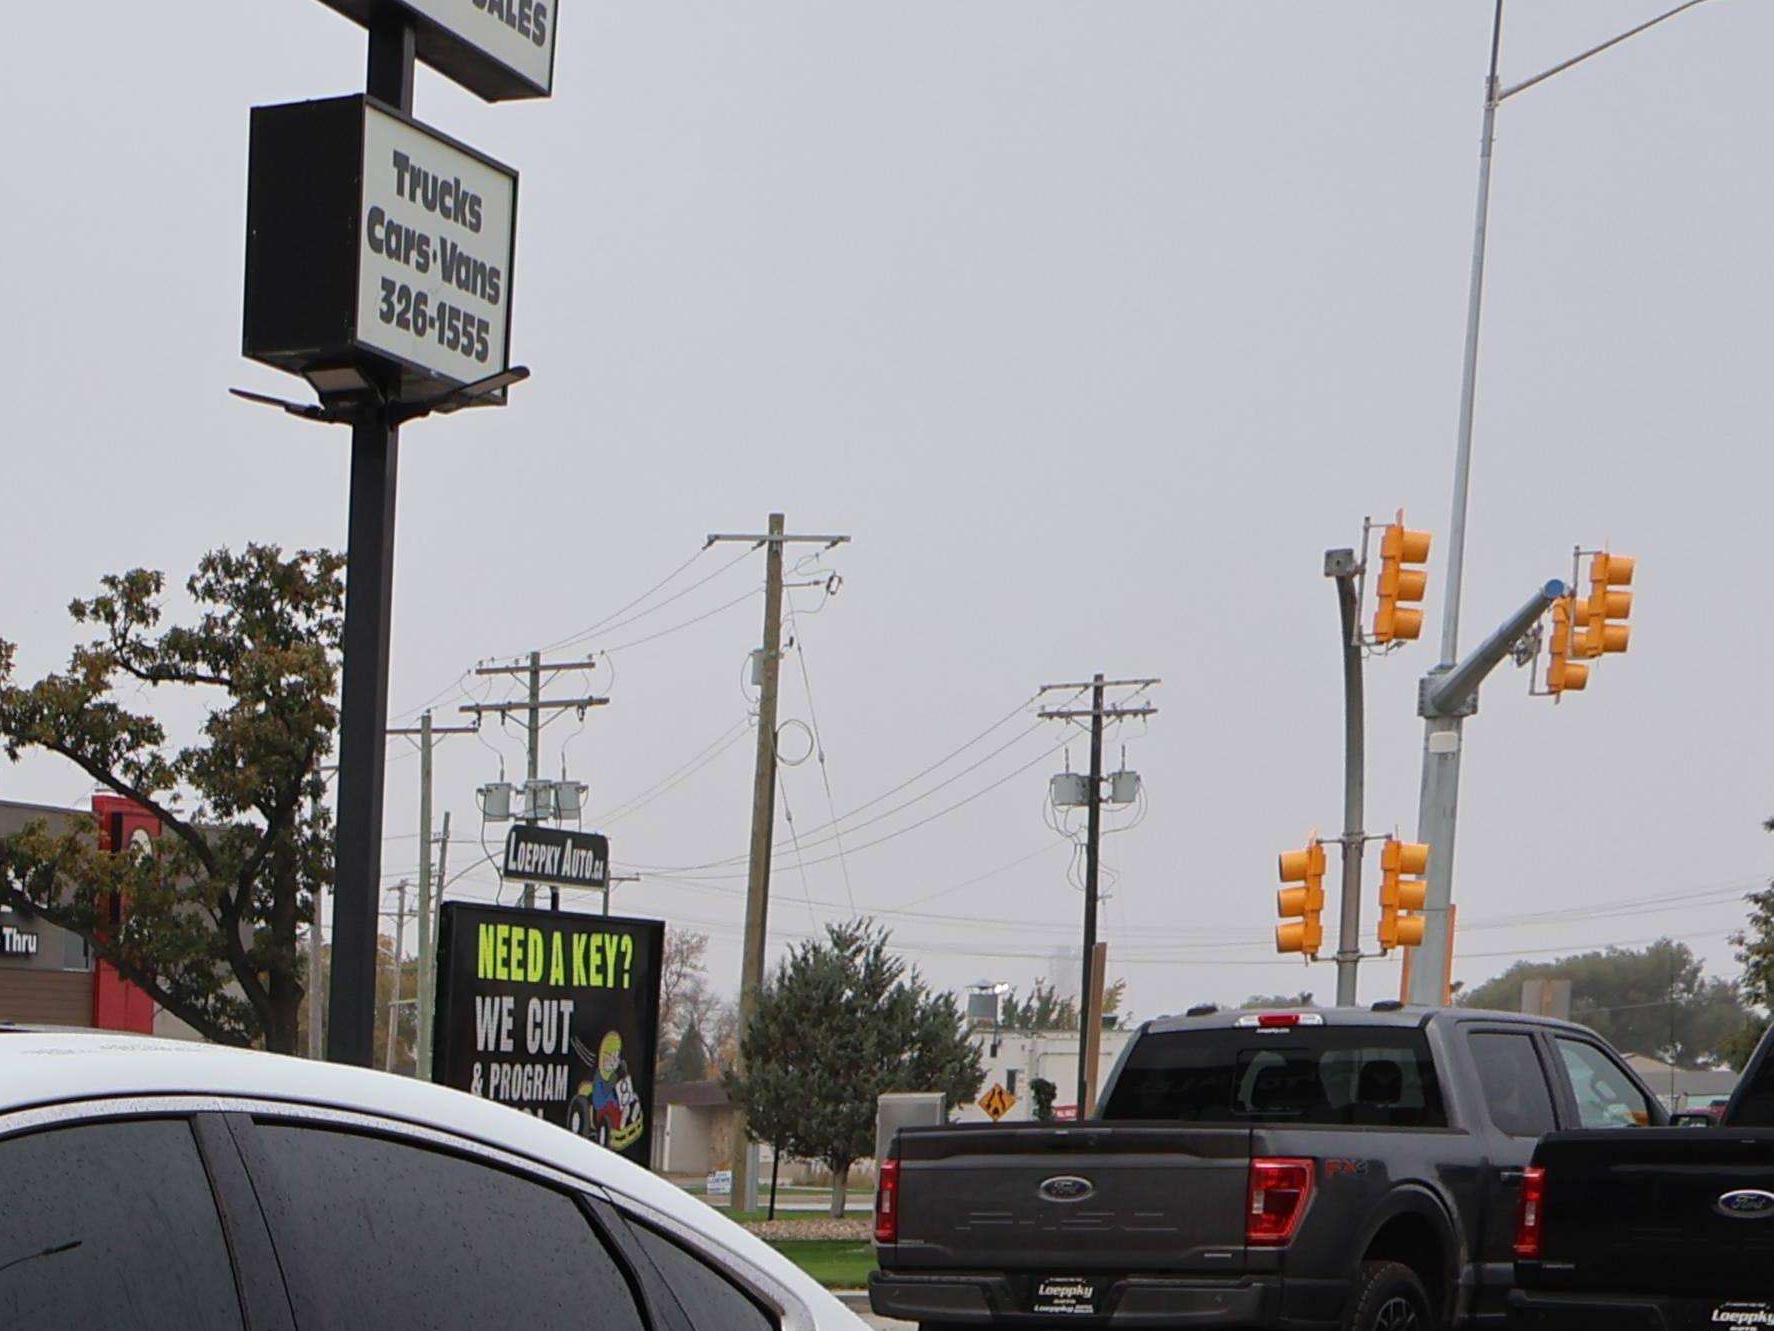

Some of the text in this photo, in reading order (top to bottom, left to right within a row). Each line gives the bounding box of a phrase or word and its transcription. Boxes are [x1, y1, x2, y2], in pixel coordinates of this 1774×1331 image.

[393, 149, 483, 234] Trucks
[379, 276, 490, 363] 326-1555
[3, 925, 37, 953] Thru
[478, 923, 633, 989] NEED A KEY?
[475, 996, 574, 1054] WE CUT
[471, 1061, 569, 1102] & PROGRAM
[1038, 1284, 1094, 1298] Loeppky
